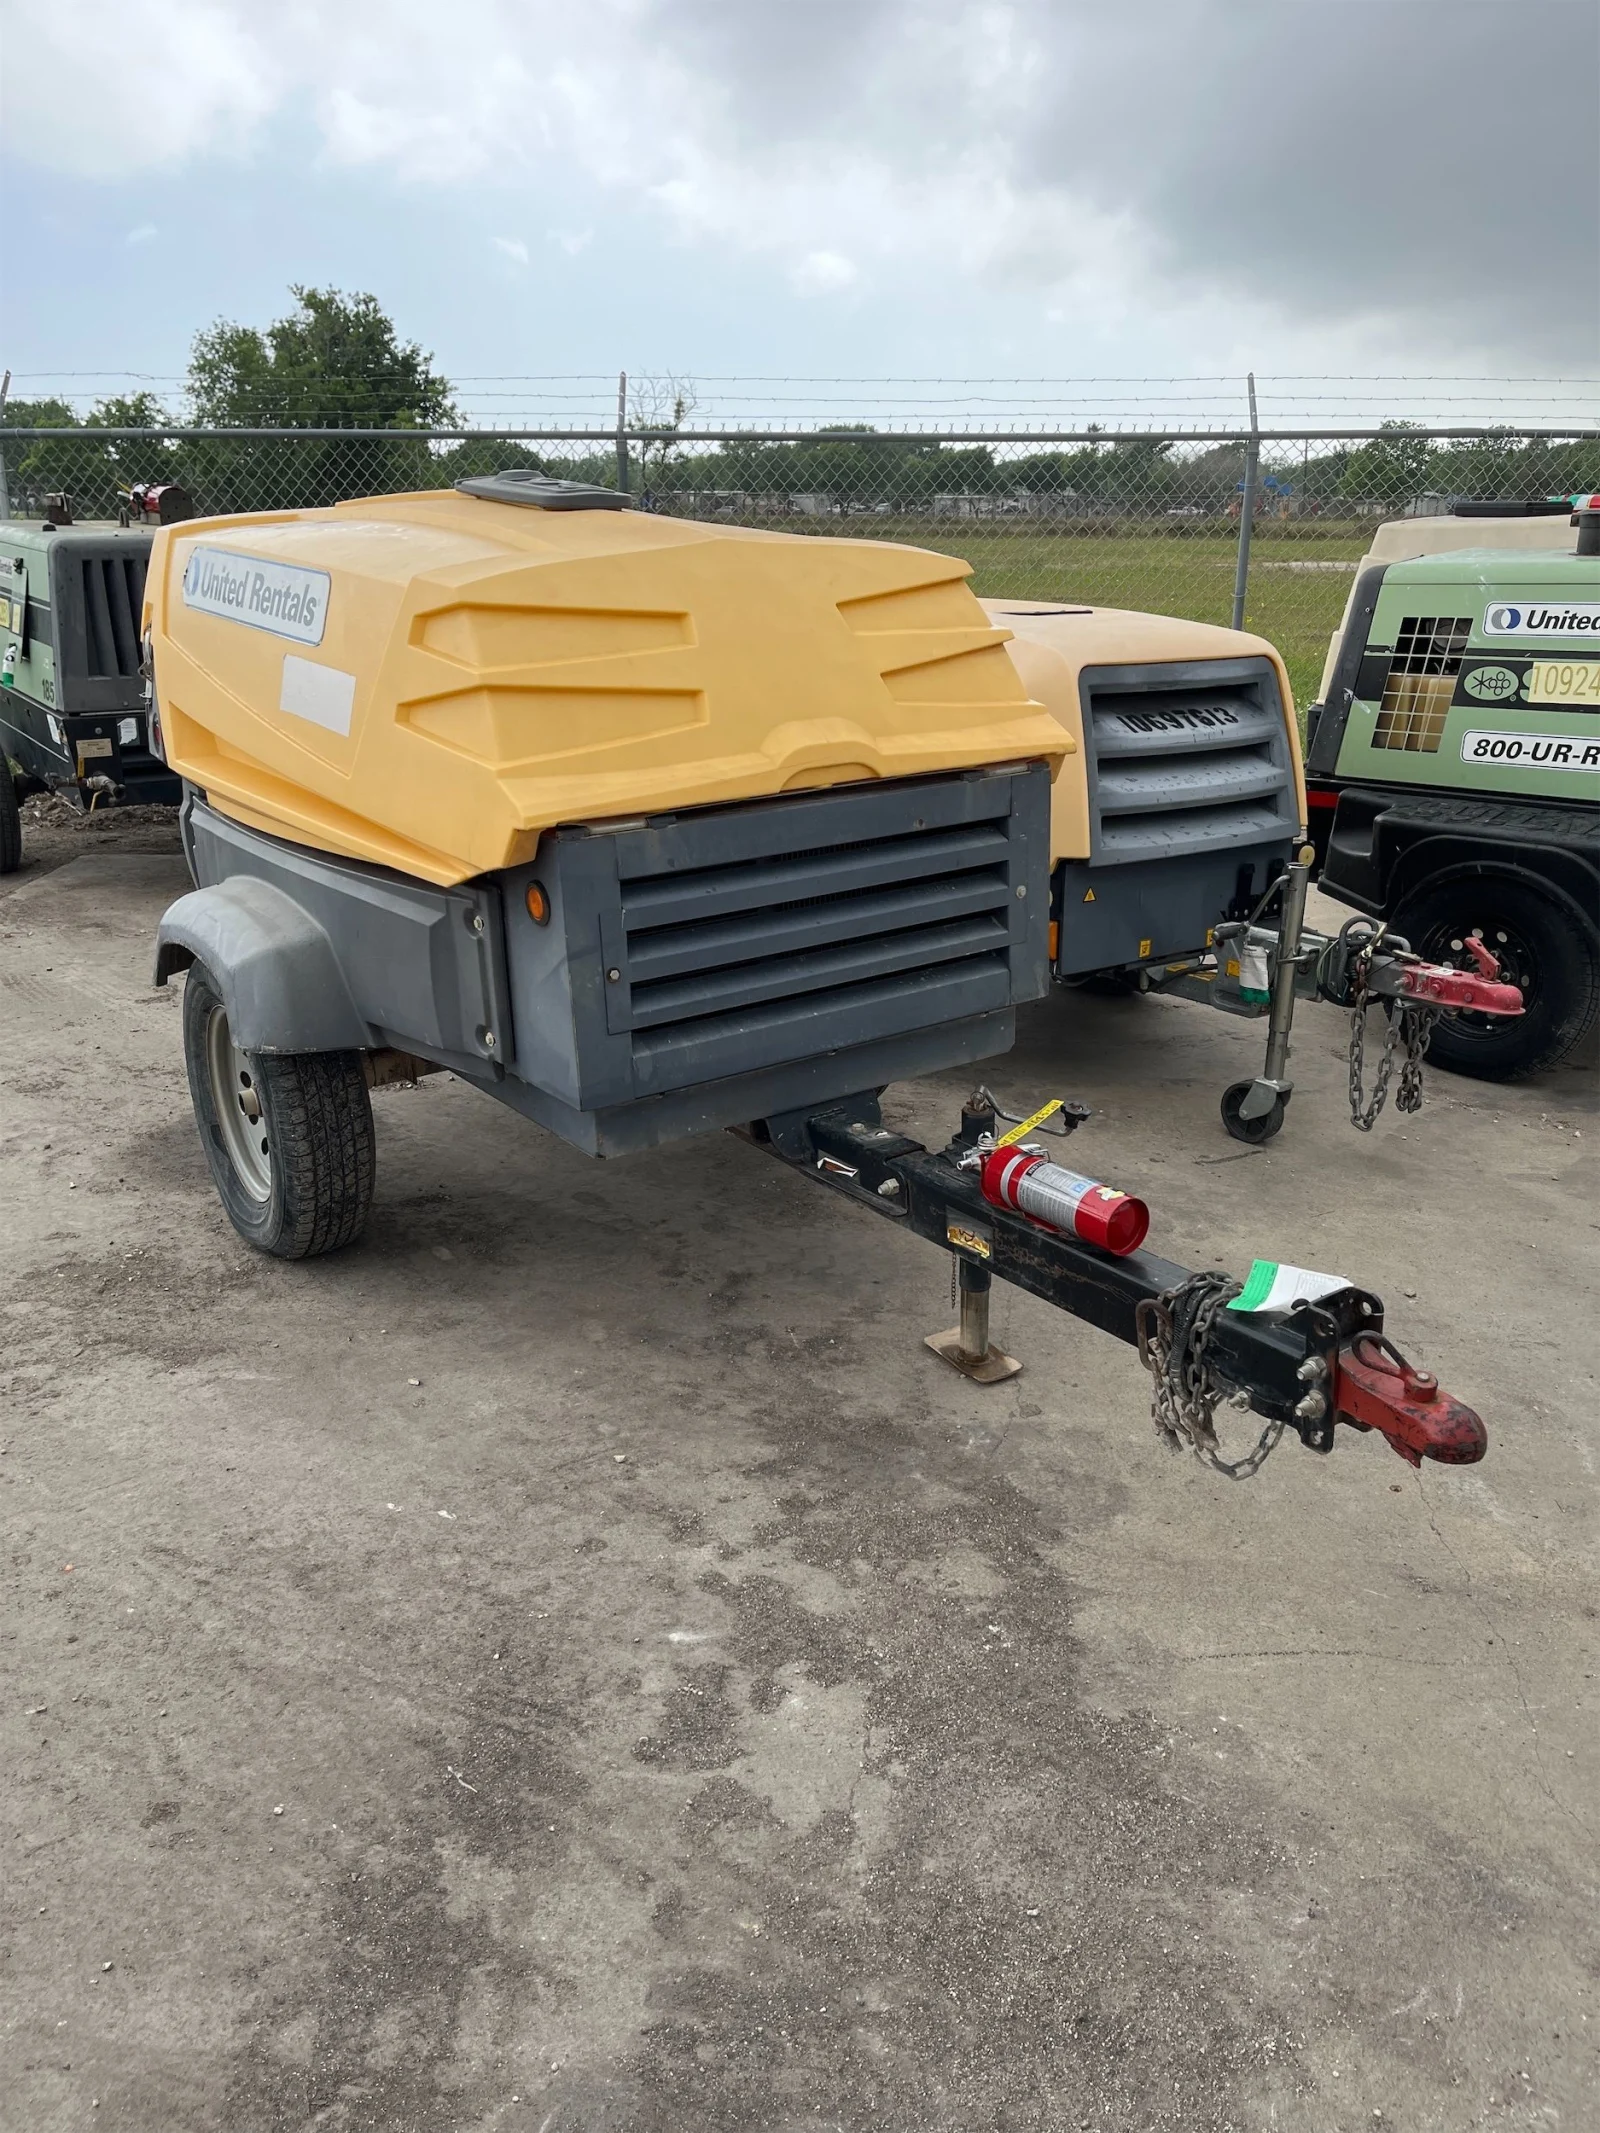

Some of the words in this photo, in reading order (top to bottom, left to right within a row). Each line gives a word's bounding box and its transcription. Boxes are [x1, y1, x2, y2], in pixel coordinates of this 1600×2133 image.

[201, 562, 248, 608] United
[249, 572, 317, 626] Rentals
[1534, 665, 1600, 696] 10924
[1473, 739, 1600, 765] 800-UR-R
